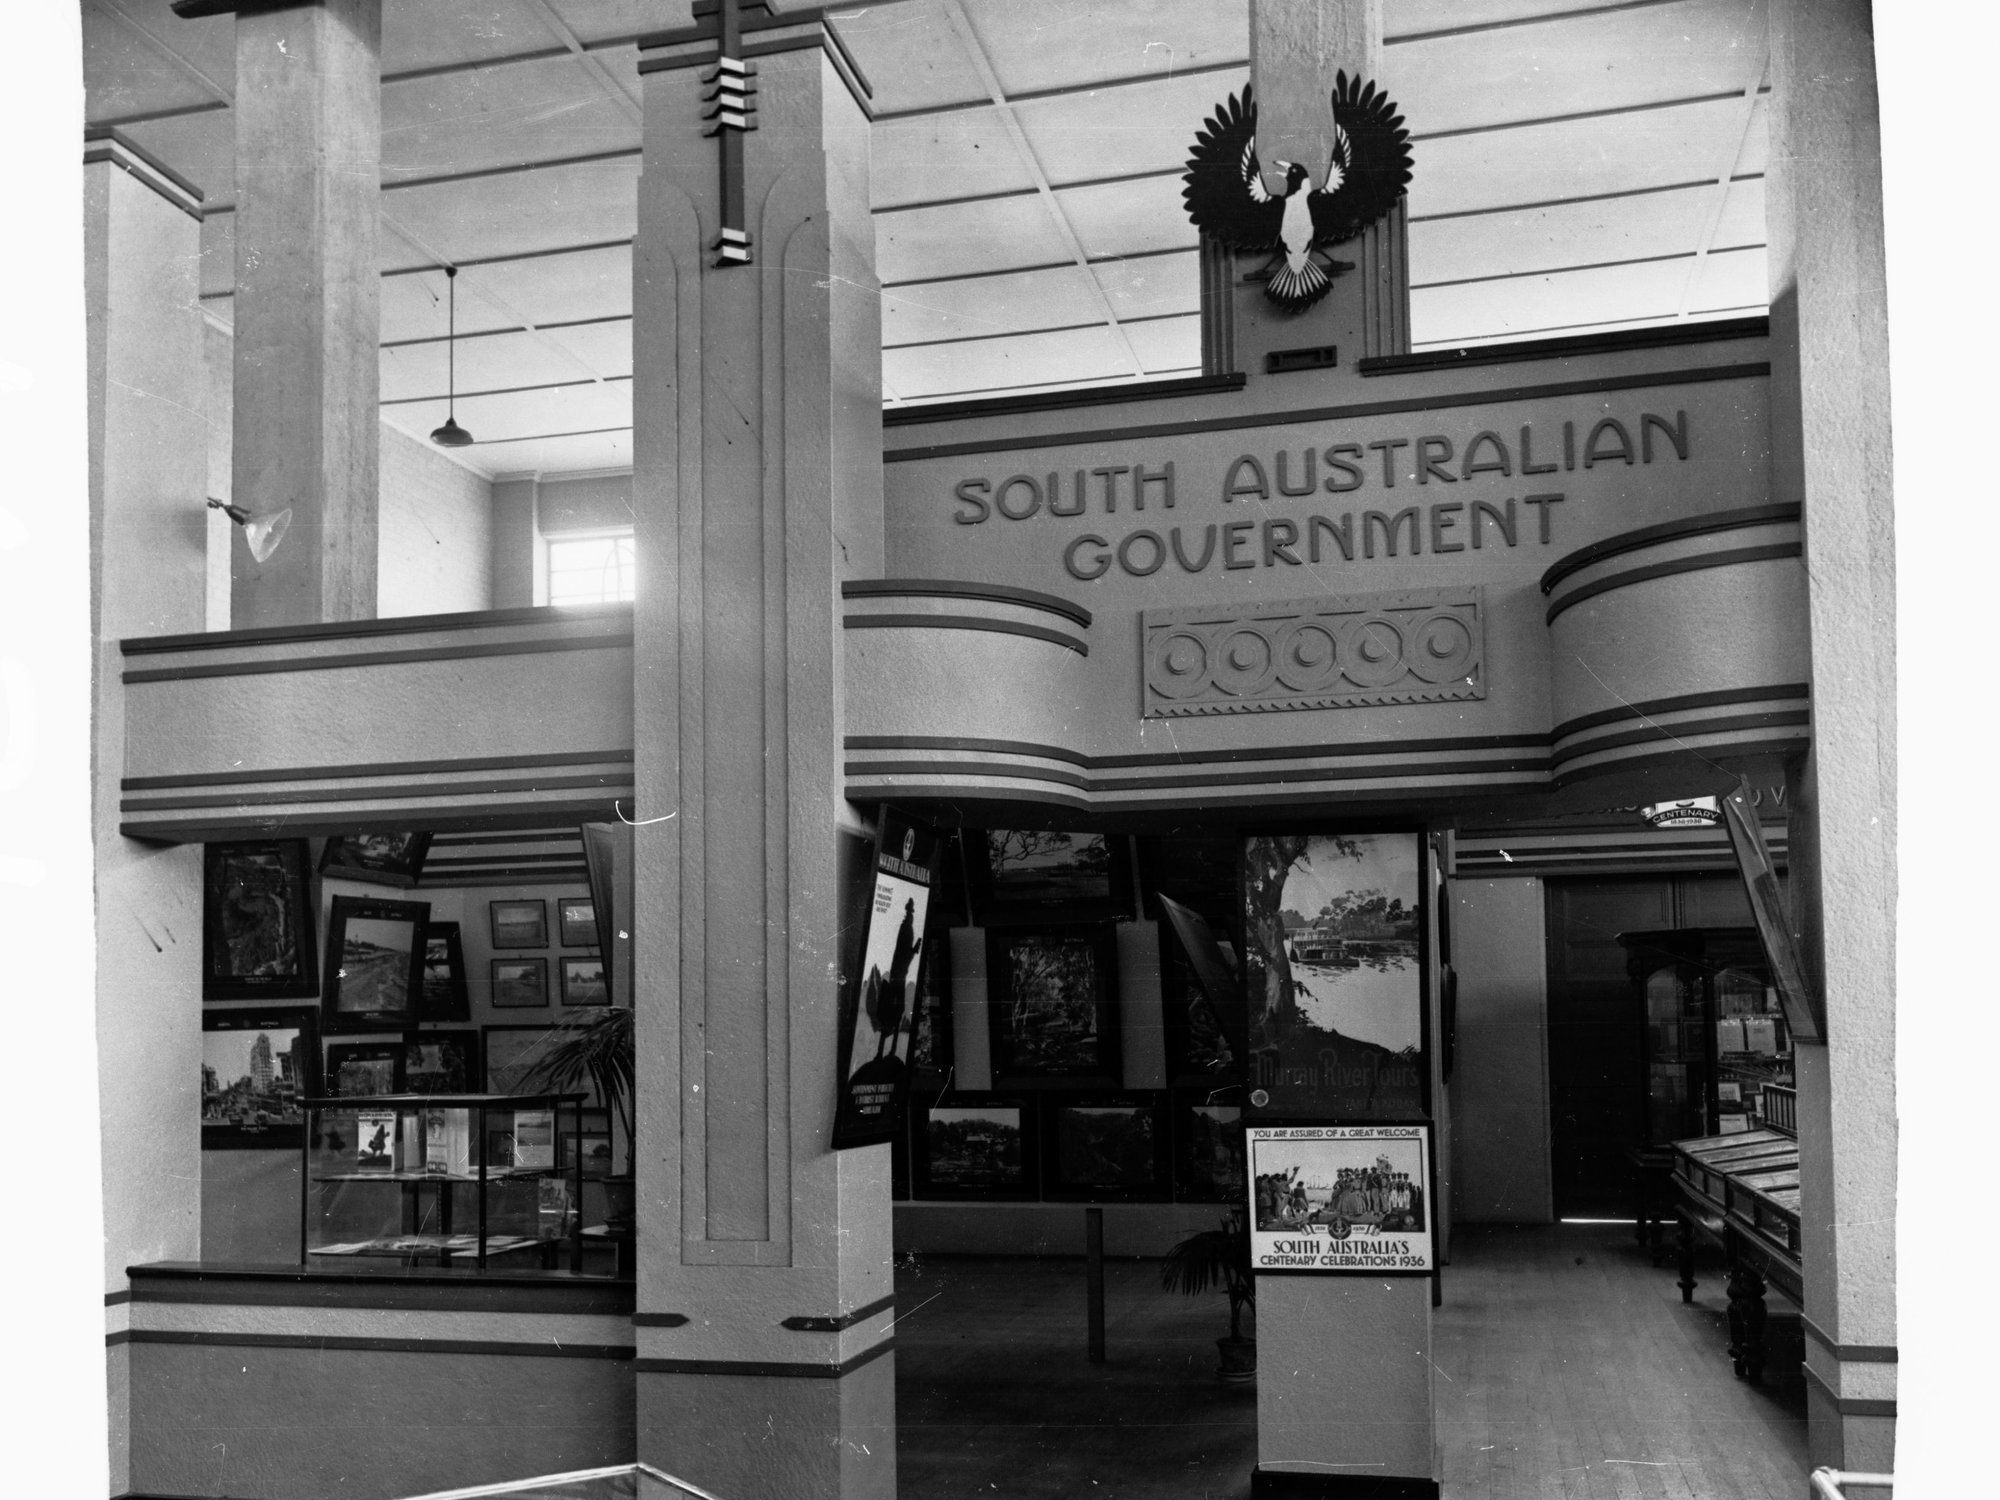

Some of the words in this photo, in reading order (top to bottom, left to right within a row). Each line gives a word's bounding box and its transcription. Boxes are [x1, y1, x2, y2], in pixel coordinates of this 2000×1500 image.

[953, 461, 1176, 524] SOUTH
[1223, 410, 1689, 503] AUSTRALIAN
[1064, 493, 1565, 580] GOVERNMENT
[1652, 808, 1718, 824] CENTENARY
[1256, 1052, 1318, 1095] Murray
[1318, 1047, 1371, 1087] River
[1360, 1049, 1420, 1087] Tours
[1254, 1129, 1271, 1138] YOU
[1273, 1129, 1288, 1138] ARE
[1289, 1129, 1324, 1138] ASSURED
[1325, 1129, 1338, 1138] OF
[1339, 1129, 1347, 1137] A
[1348, 1128, 1375, 1137] GREAT
[1376, 1128, 1420, 1137] WELCOME
[1273, 1239, 1320, 1255] SOUTH
[1326, 1239, 1410, 1255] AUSTRALIA'S
[1259, 1255, 1317, 1266] CENTENARY
[1319, 1255, 1397, 1267] CELEBRATIONS
[1399, 1256, 1426, 1267] 1936
